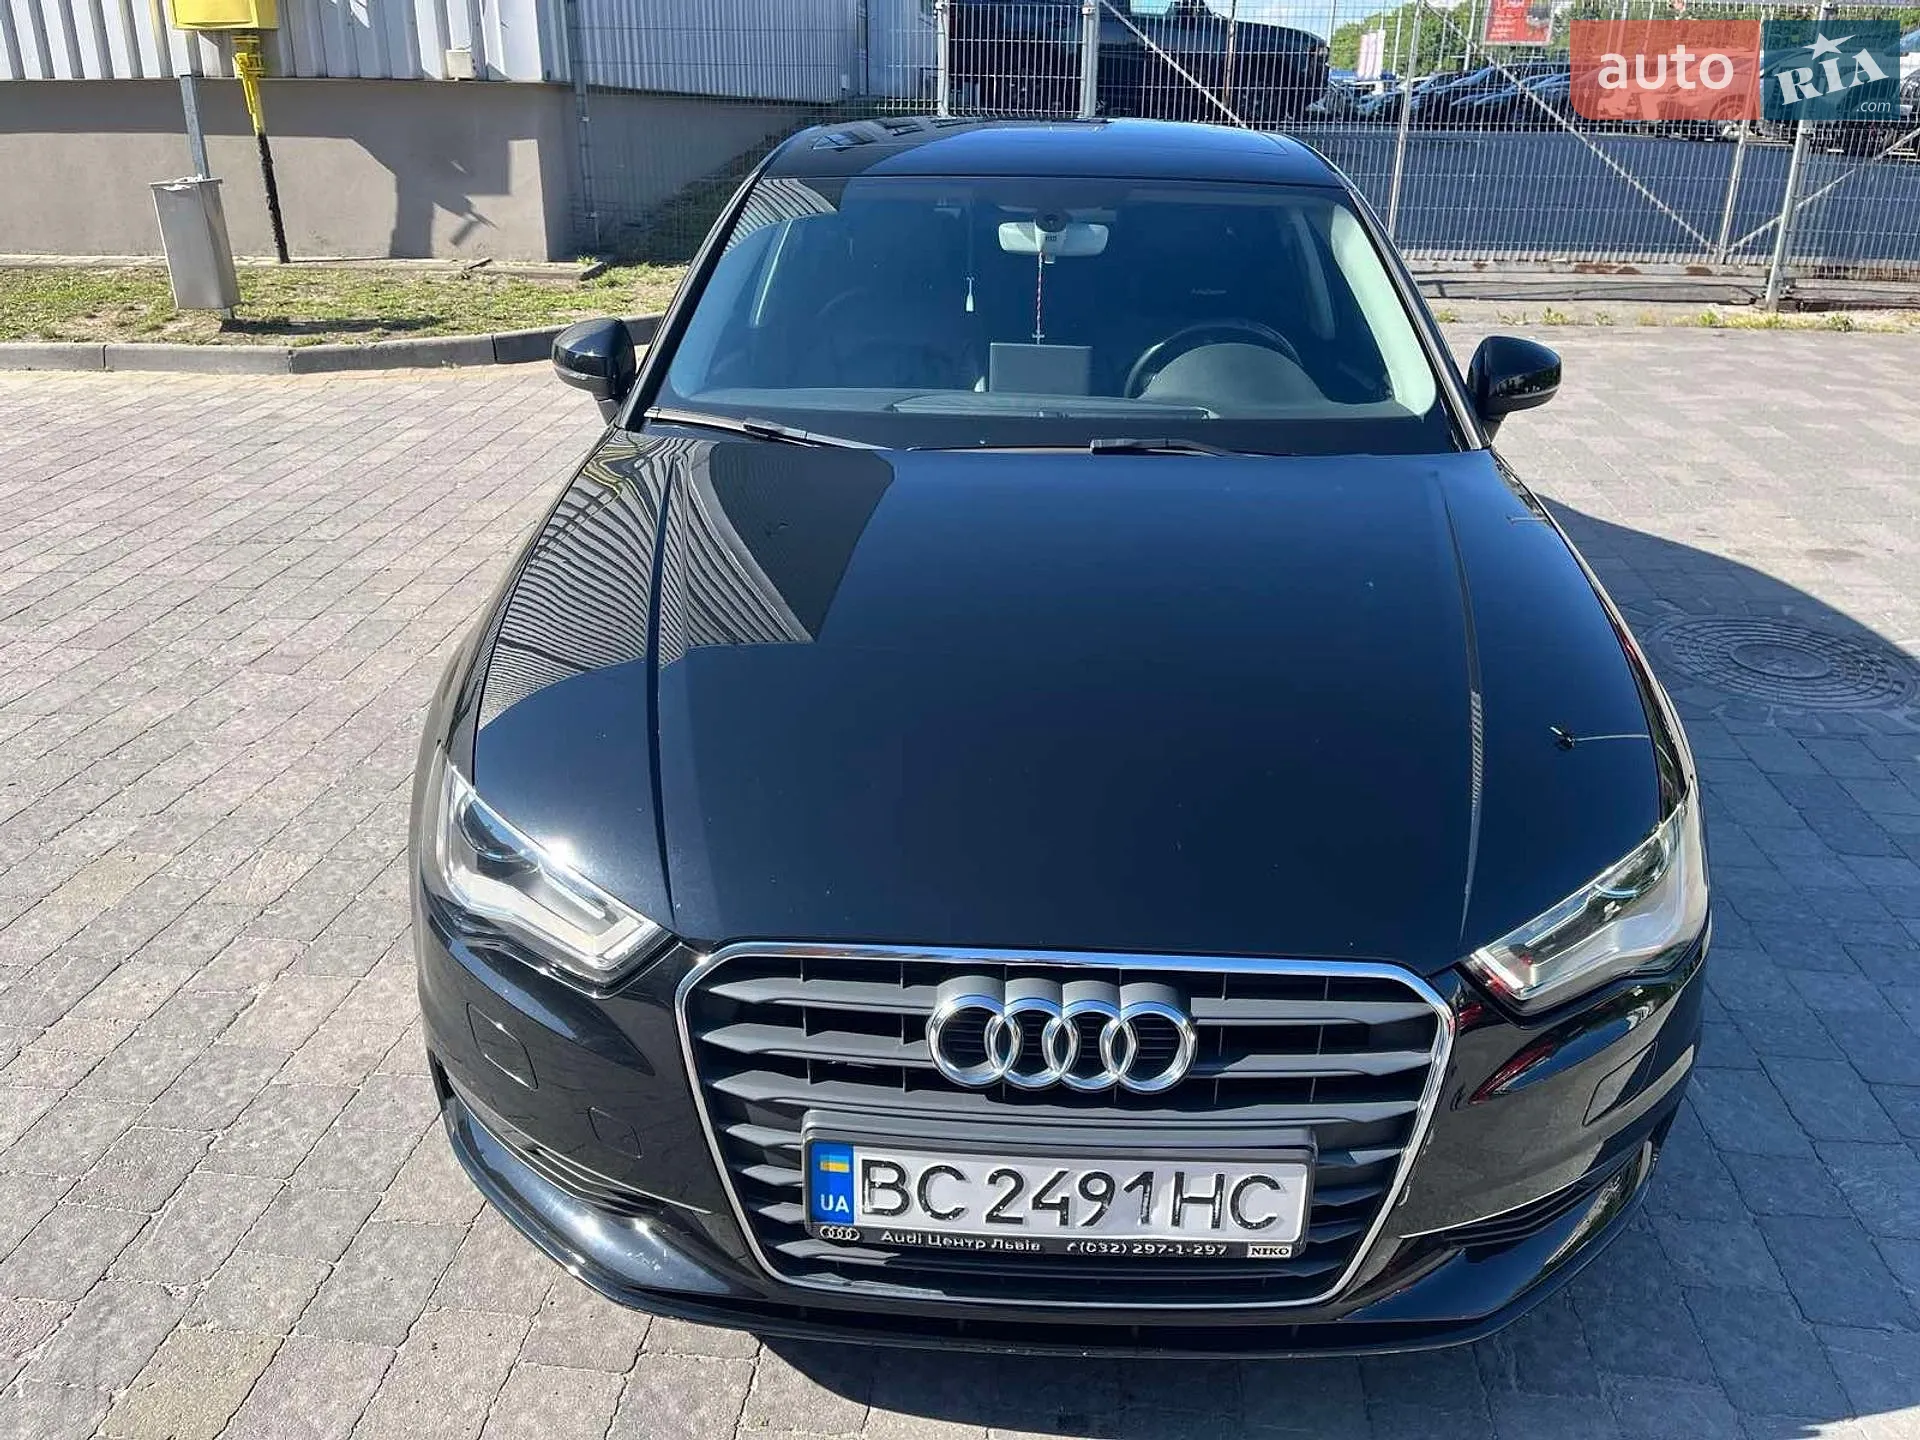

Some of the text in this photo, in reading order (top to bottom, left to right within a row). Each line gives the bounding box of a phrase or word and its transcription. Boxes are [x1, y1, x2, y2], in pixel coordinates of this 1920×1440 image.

[820, 1193, 849, 1213] UA
[861, 1158, 1282, 1231] BC 2491 HC
[880, 1230, 921, 1244] Audi
[928, 1234, 986, 1250] Центр
[1250, 1245, 1290, 1257] NIKO
